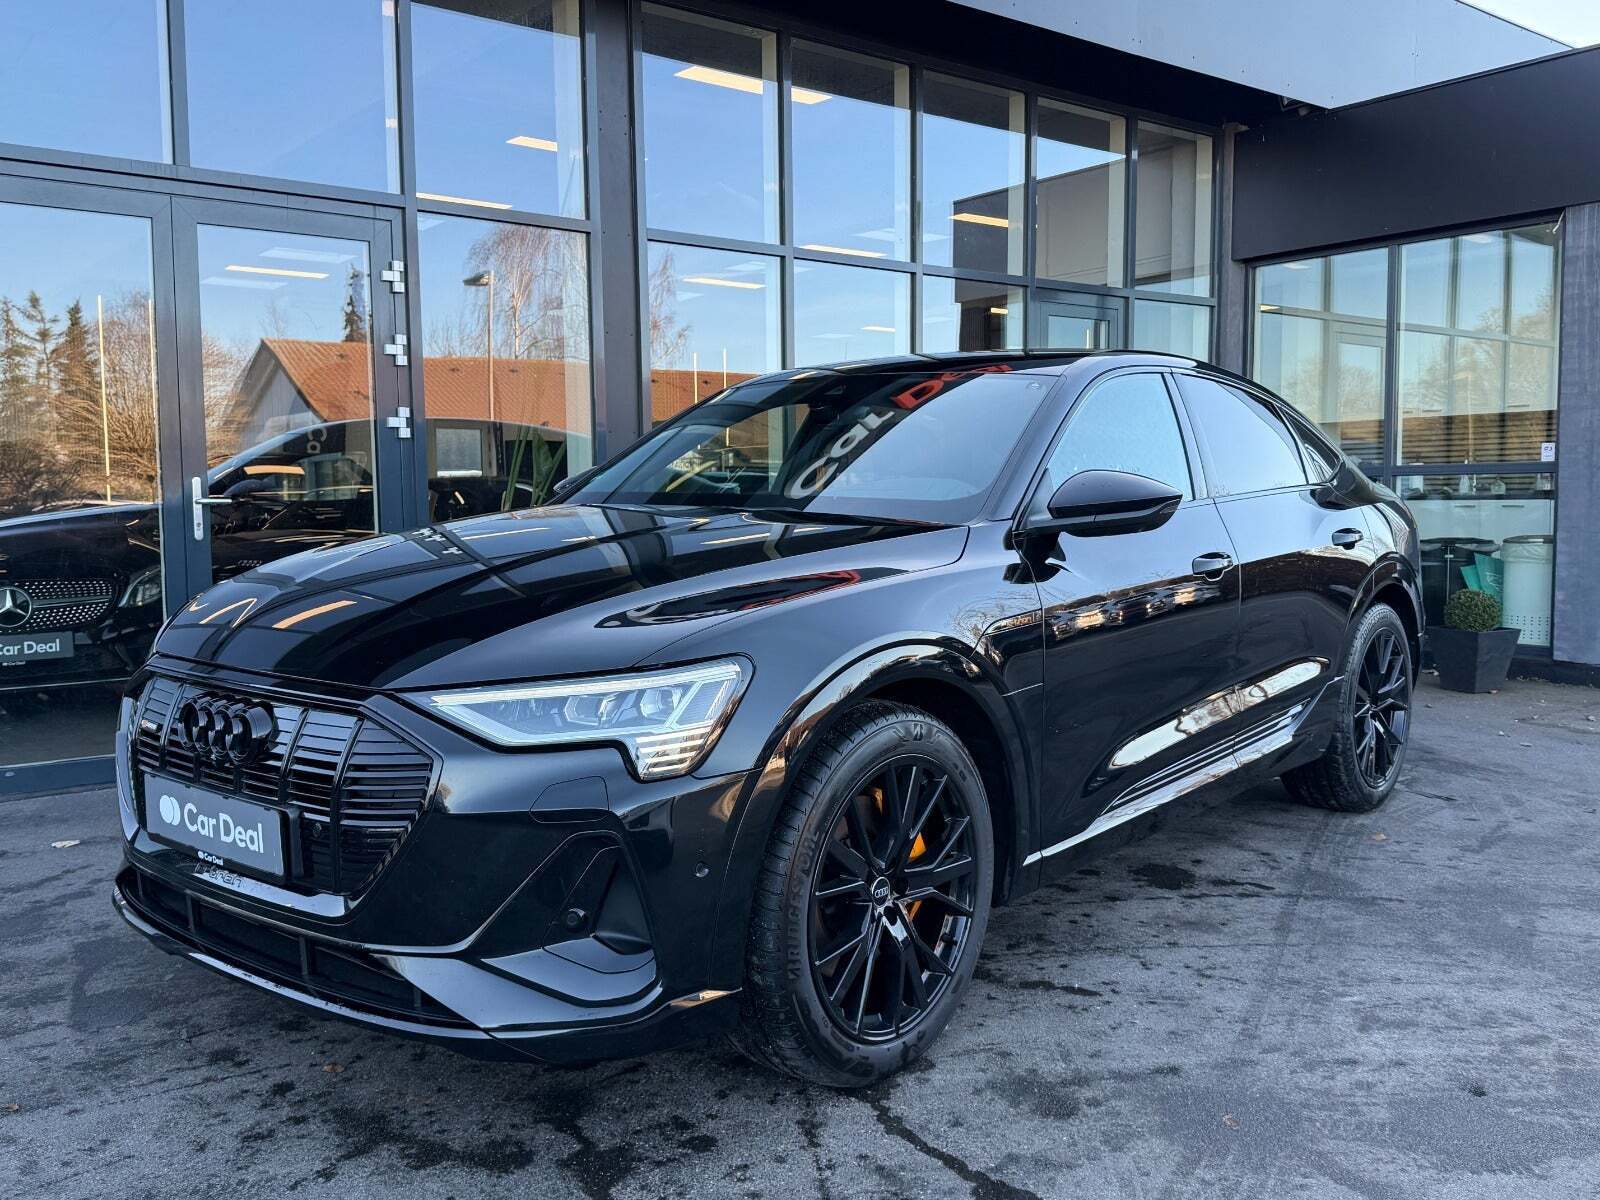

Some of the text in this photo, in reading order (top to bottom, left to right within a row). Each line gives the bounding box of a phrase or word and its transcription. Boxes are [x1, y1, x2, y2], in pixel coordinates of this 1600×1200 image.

[23, 638, 60, 655] Deal
[183, 802, 264, 854] Car Deal
